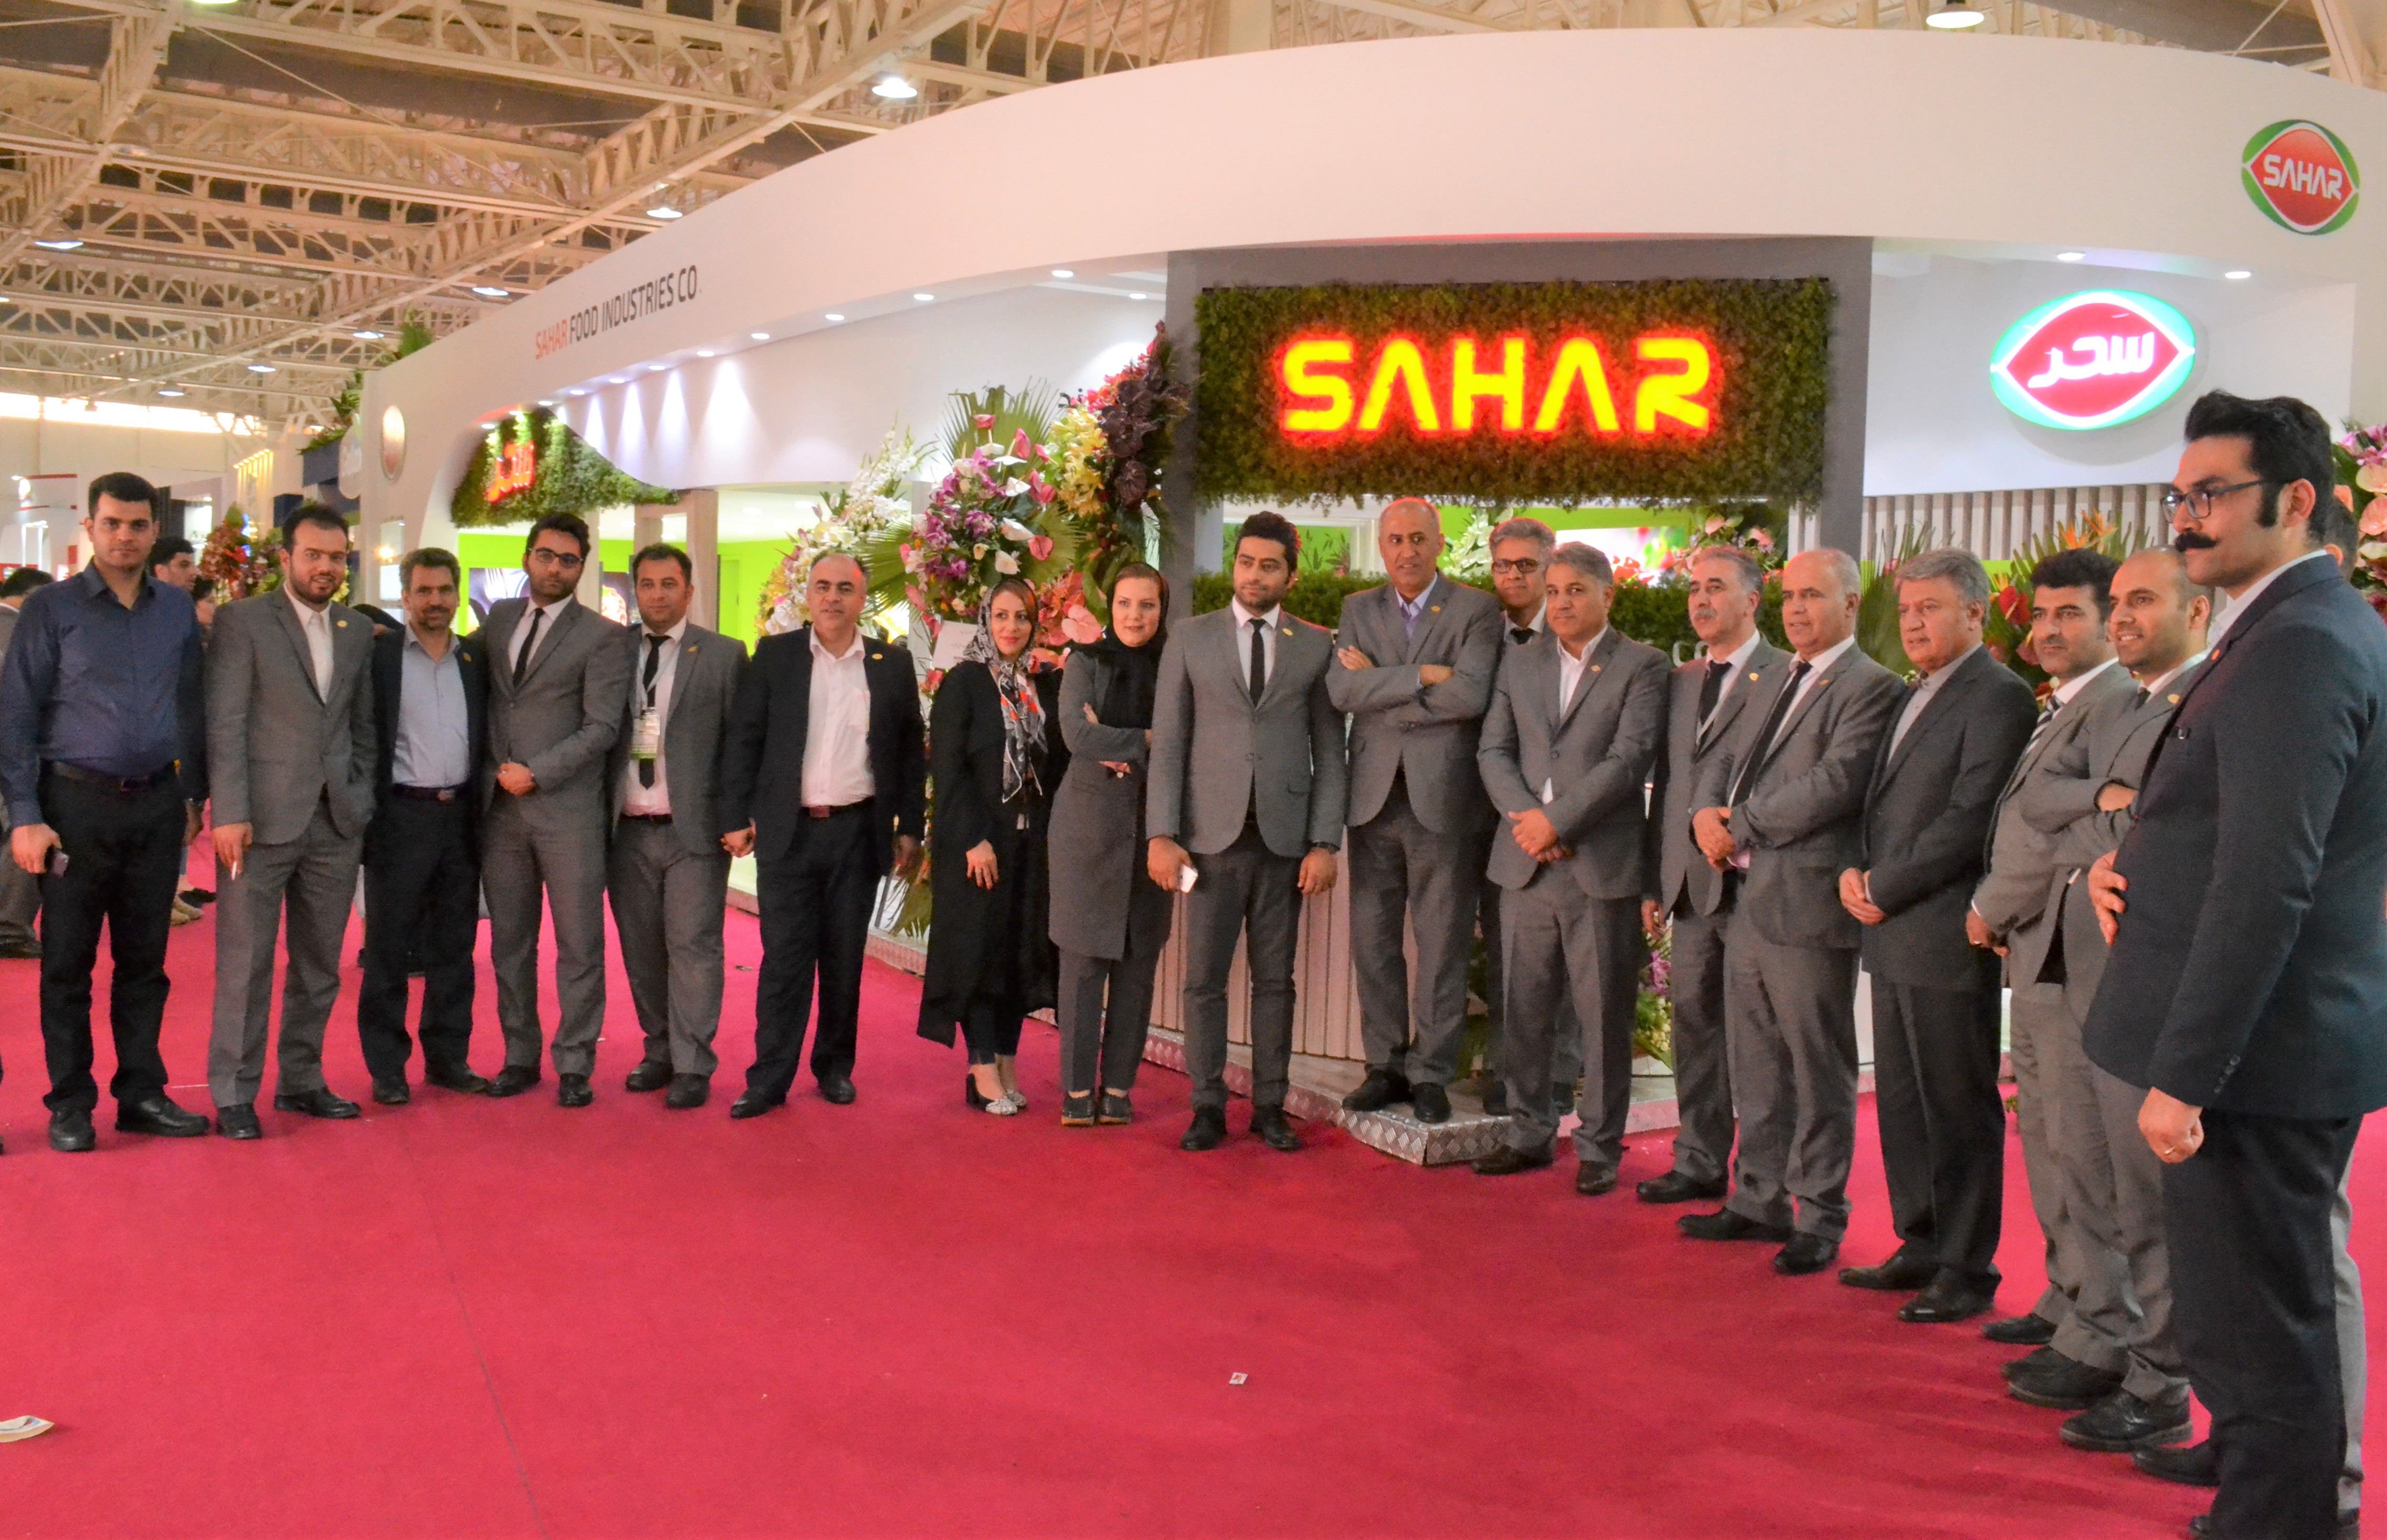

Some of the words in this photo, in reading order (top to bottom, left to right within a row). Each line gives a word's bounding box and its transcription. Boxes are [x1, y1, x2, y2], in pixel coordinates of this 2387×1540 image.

[2263, 153, 2344, 201] SAHAR
[535, 319, 568, 359] SAHAR
[570, 305, 598, 344] FOOD
[601, 272, 674, 332] INDUSTRIES
[1280, 335, 1713, 436] SAHAR
[2027, 331, 2155, 389] سحر
